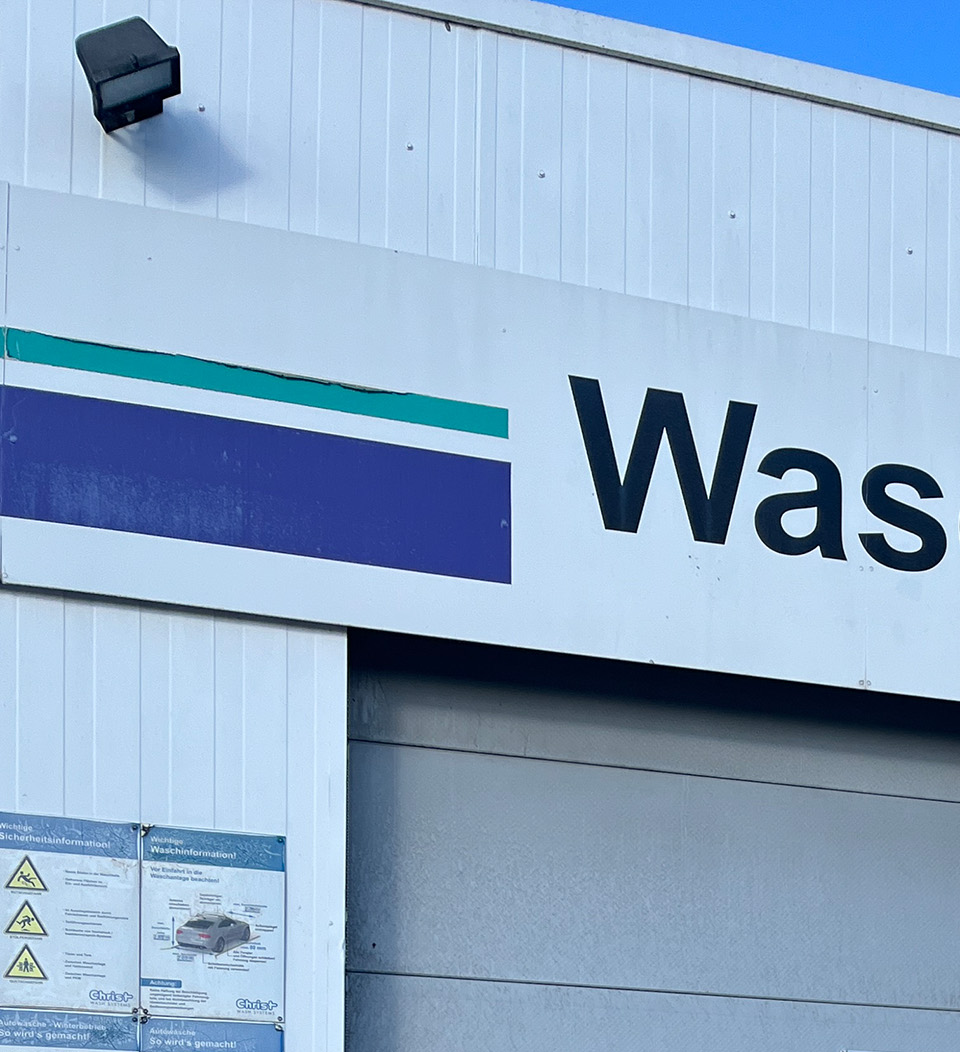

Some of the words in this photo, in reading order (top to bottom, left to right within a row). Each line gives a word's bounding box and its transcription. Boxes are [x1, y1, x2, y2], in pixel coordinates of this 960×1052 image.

[150, 845, 237, 860] Waschinformation!
[88, 989, 134, 1003] Christ
[235, 998, 279, 1011] Christ
[149, 1036, 162, 1046] So
[164, 1038, 192, 1047] wird's
[194, 1039, 237, 1049] gemacht!
